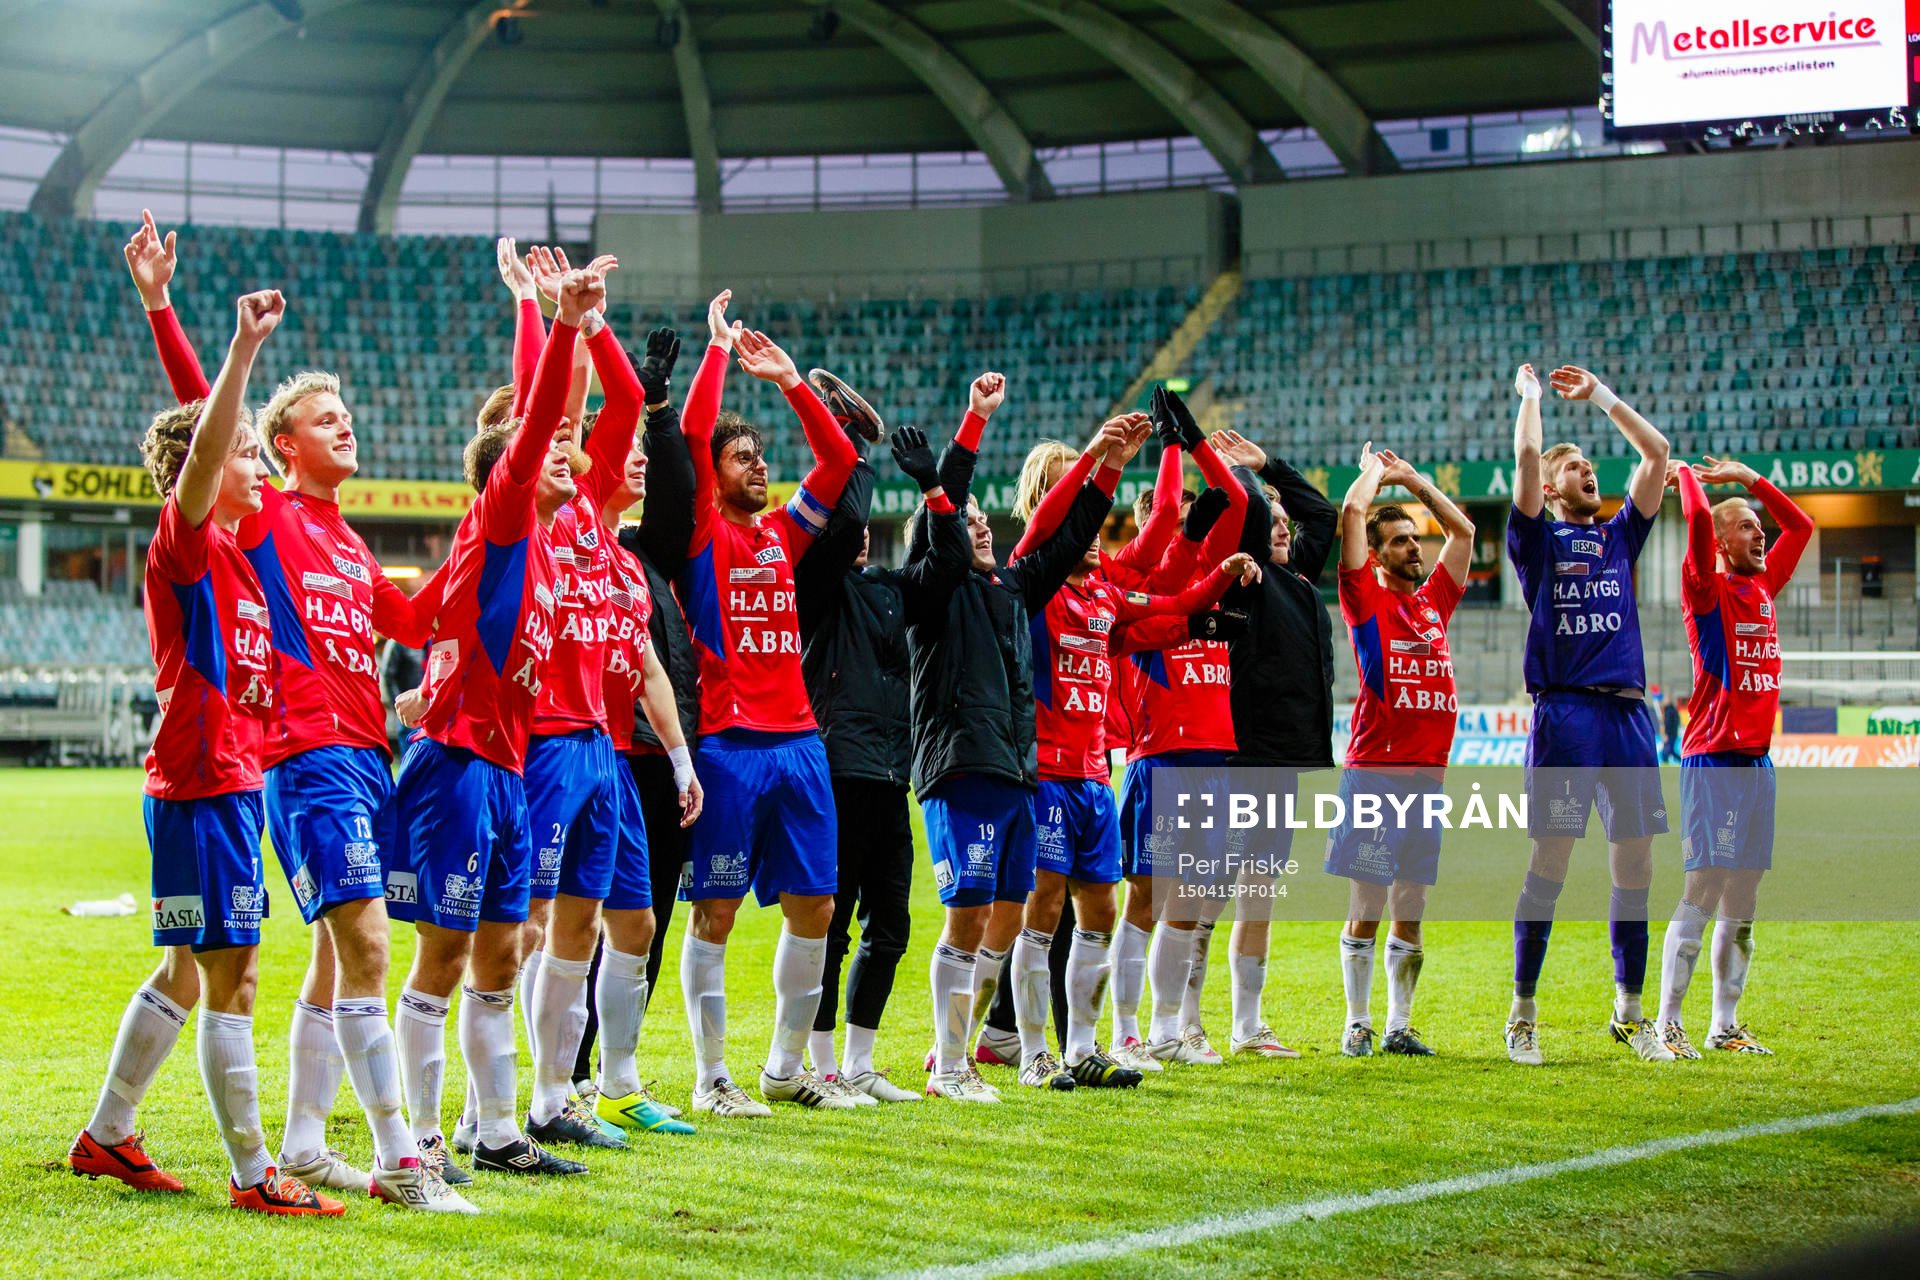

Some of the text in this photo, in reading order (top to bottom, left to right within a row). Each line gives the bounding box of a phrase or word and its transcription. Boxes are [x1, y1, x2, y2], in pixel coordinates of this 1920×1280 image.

[1631, 11, 1876, 64] Metallservice
[1767, 458, 1854, 488] ÅBRO
[1573, 541, 1597, 554] BESAB
[334, 556, 362, 579] BESAB
[1554, 580, 1620, 599] H.A BYGG
[306, 596, 349, 625] H.A
[730, 591, 797, 612] H.A BY
[1556, 612, 1621, 635] ÅBRO
[1059, 653, 1091, 676] H.A
[1389, 656, 1420, 676] H.A
[1394, 686, 1458, 713] ÅBRO
[1048, 805, 1063, 824] 18
[1155, 815, 1175, 833] 85
[978, 823, 995, 841] 19
[467, 851, 479, 873] 6
[156, 909, 204, 929] RASTA
